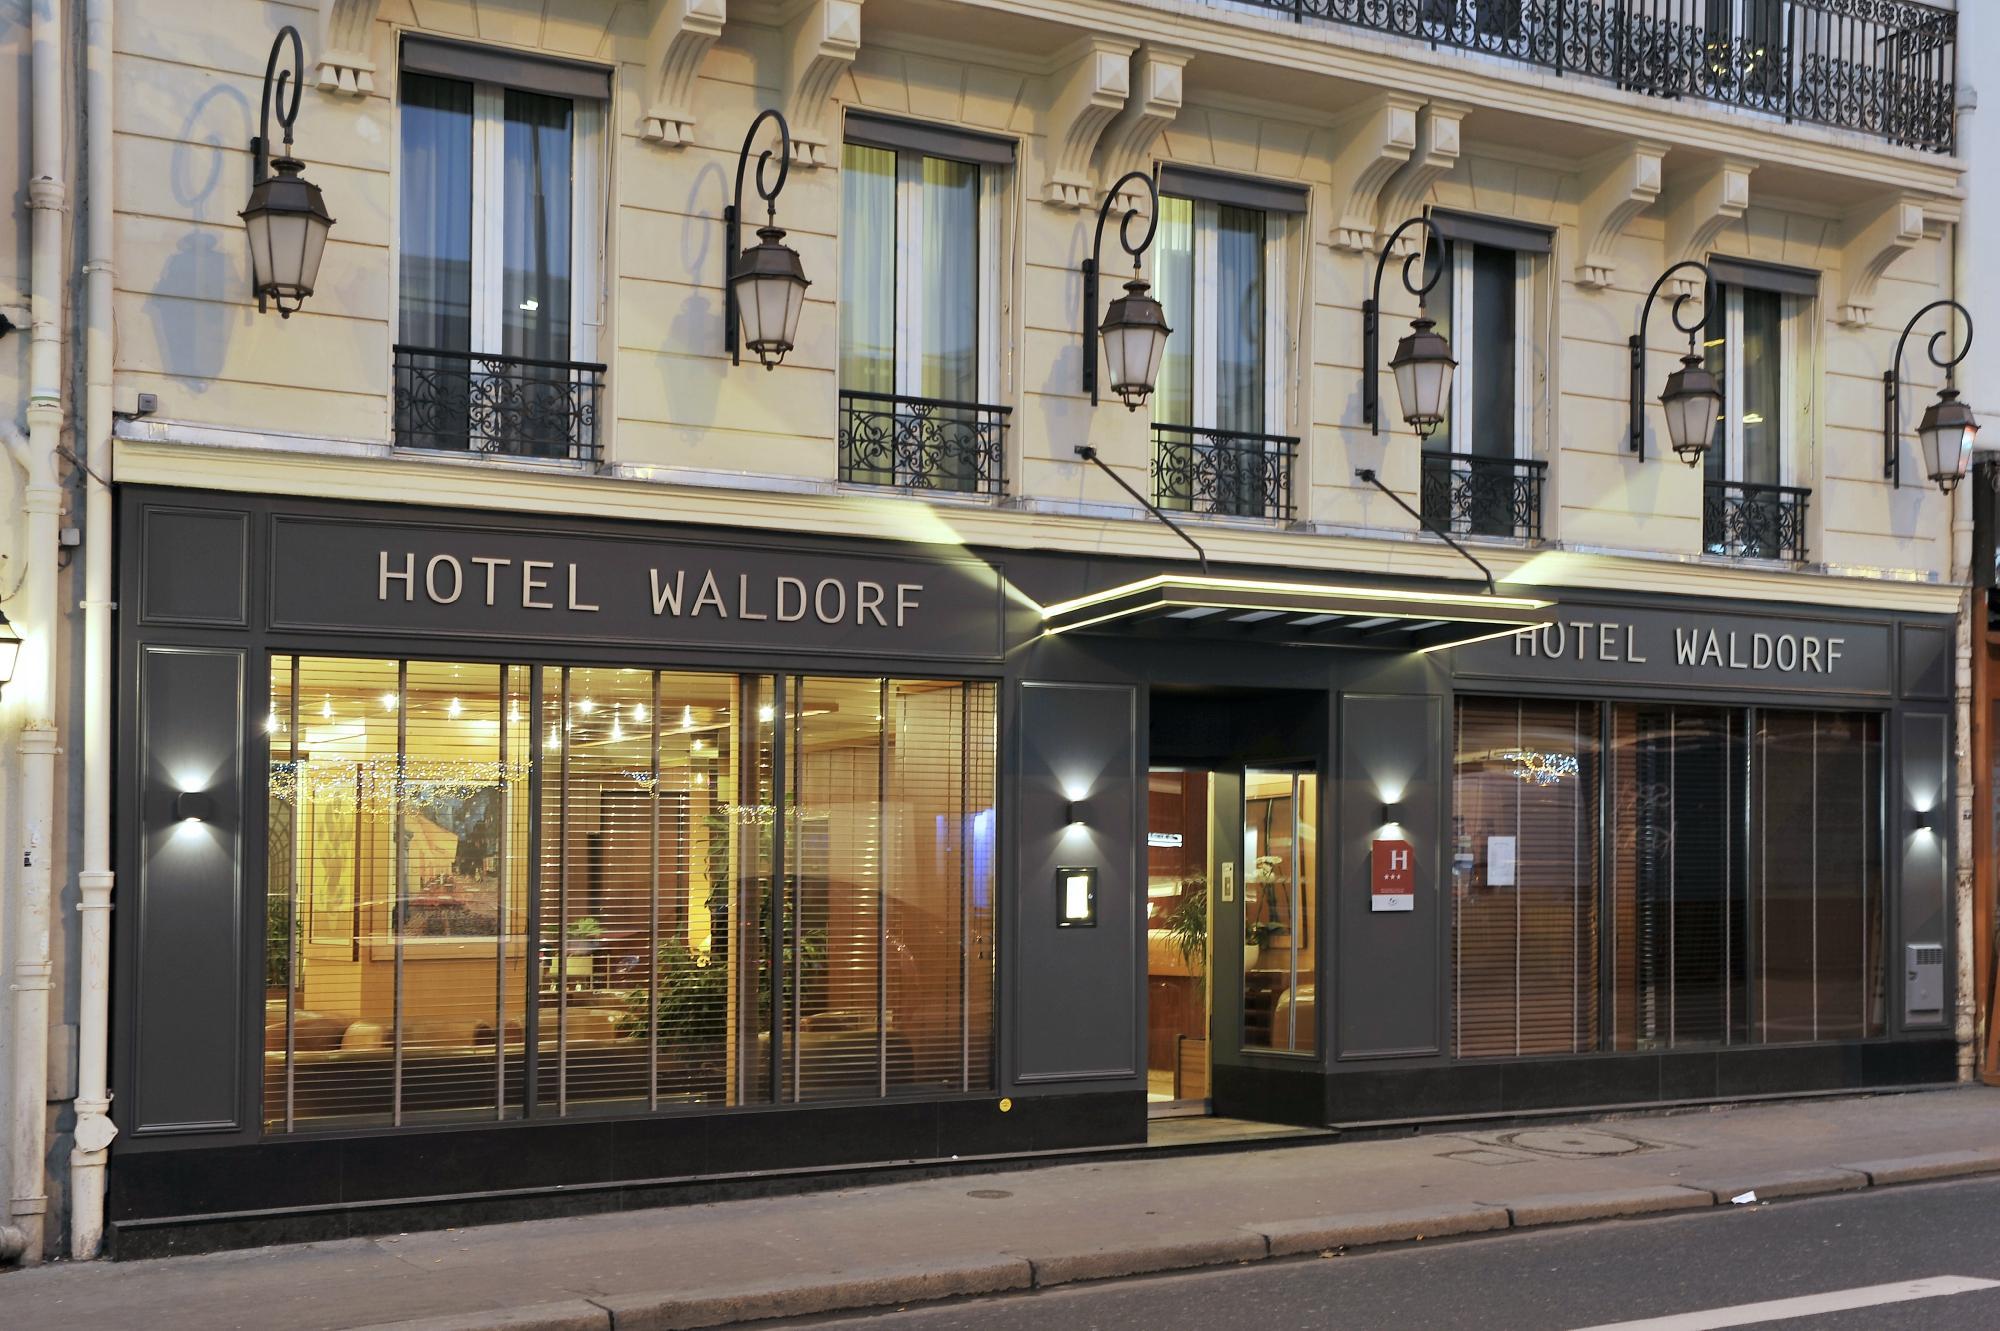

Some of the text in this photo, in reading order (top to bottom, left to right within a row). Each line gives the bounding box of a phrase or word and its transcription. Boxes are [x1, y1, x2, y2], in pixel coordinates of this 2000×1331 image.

[377, 551, 924, 628] HOTEL WALDORF
[1515, 620, 1846, 674] HOTEL WALDORF
[1391, 850, 1408, 870] H
